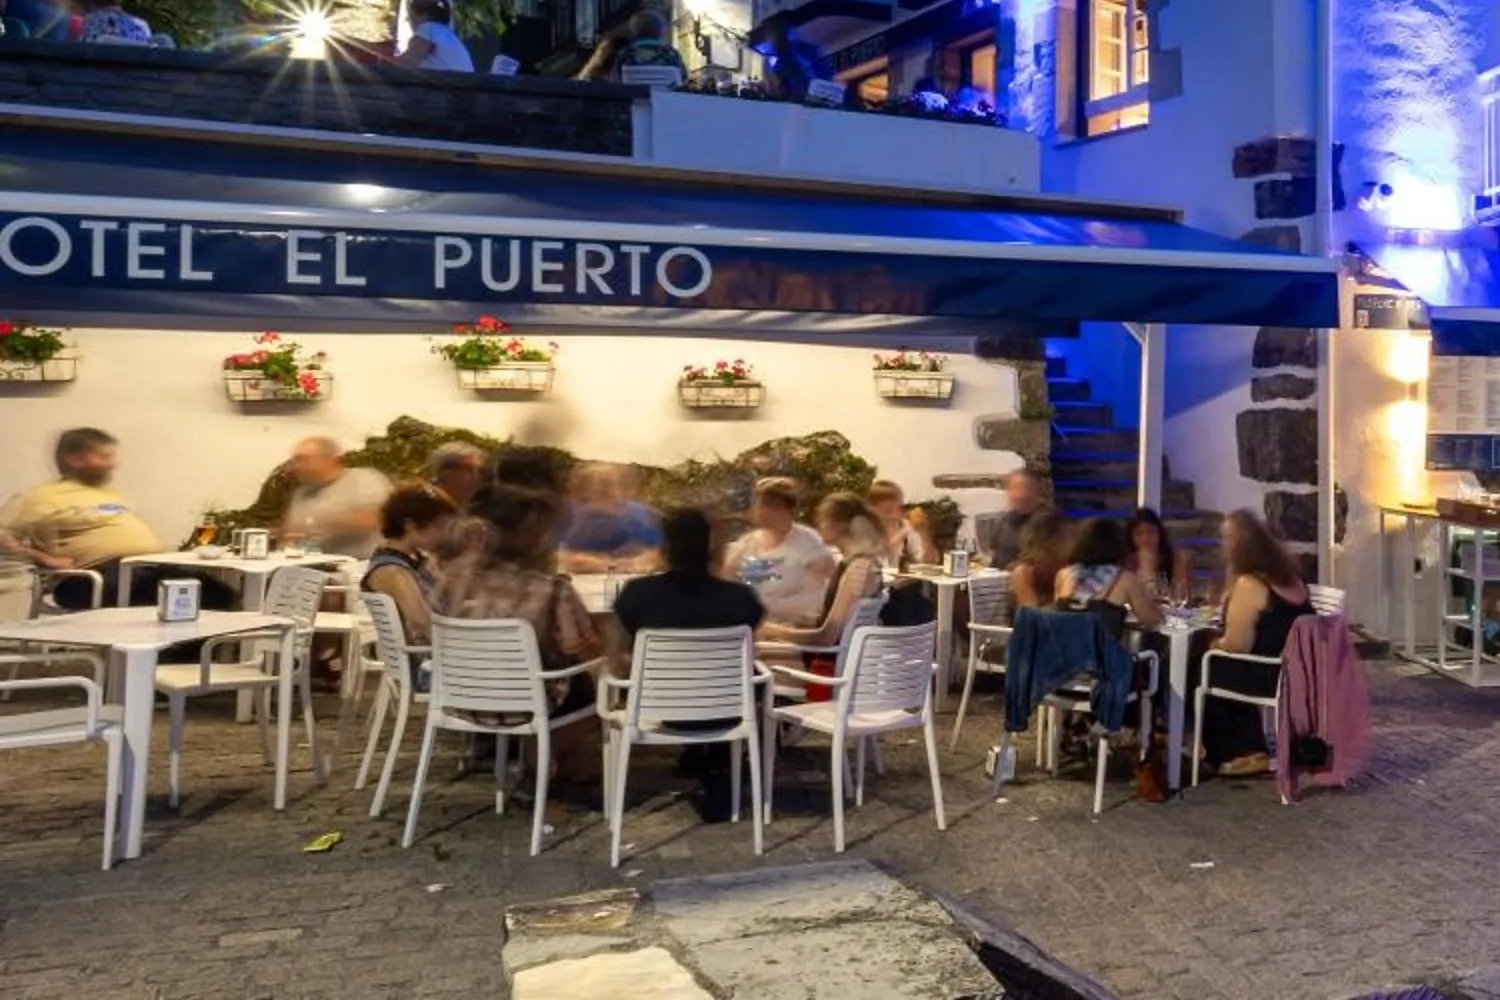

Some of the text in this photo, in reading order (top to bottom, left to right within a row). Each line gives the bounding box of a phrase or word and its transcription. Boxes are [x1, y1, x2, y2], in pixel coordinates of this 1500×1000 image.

[0, 216, 713, 298] OTEL EL PUERTO
